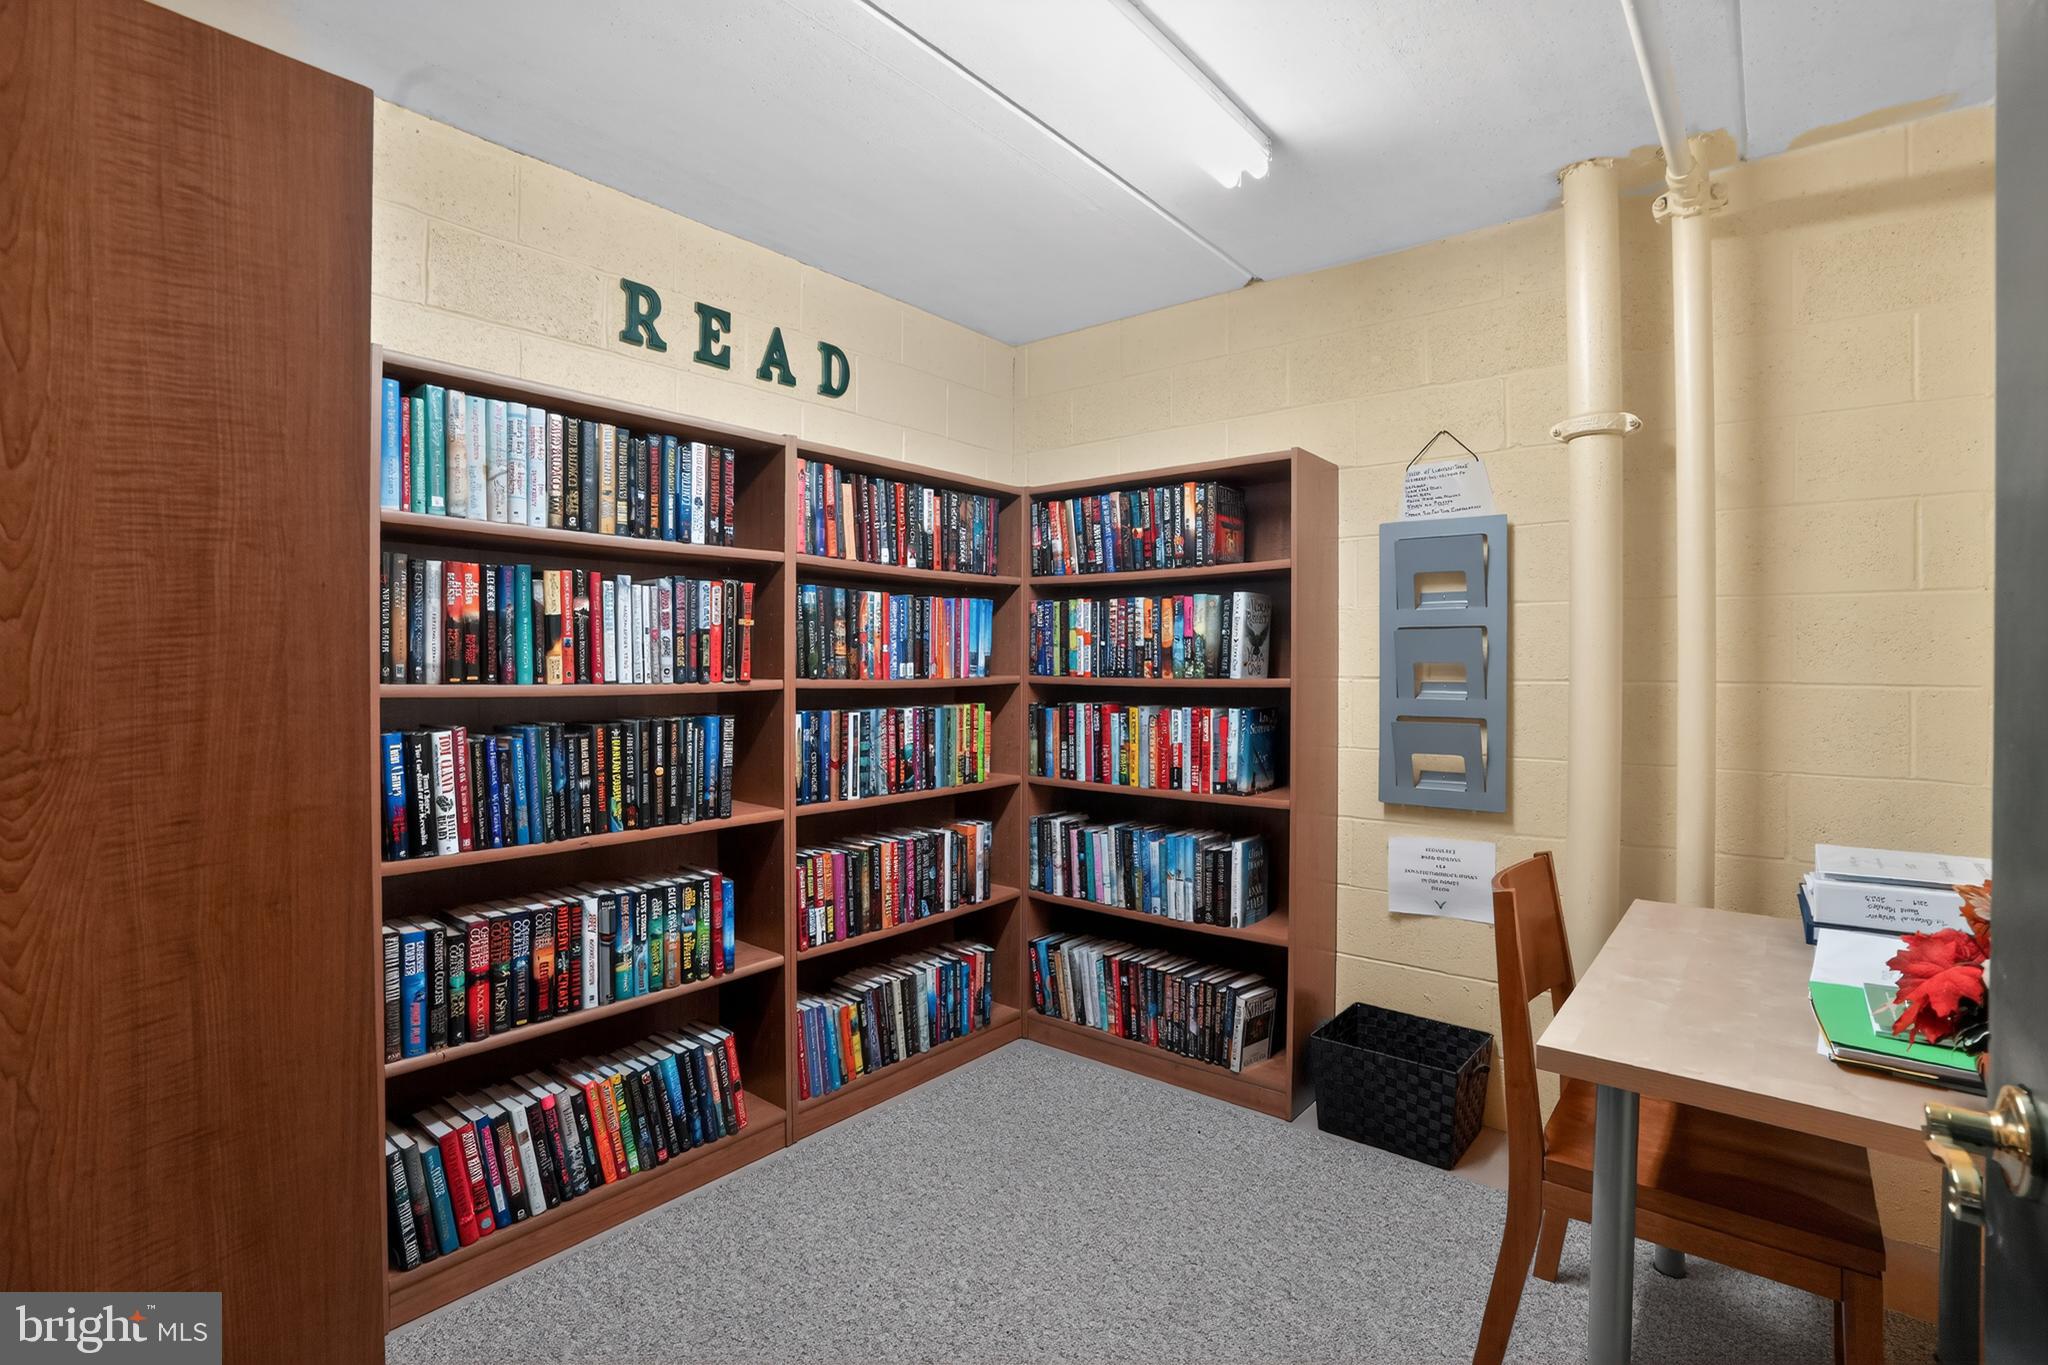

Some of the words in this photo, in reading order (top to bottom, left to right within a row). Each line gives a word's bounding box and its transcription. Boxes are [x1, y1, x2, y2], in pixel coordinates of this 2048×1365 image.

[619, 277, 850, 398] READ
[389, 743, 403, 764] Tom
[439, 734, 452, 757] TOM
[388, 766, 404, 797] Clancy
[440, 758, 455, 795] CLANCY
[556, 905, 569, 951] ROBERT
[557, 973, 569, 1008] CRAIS
